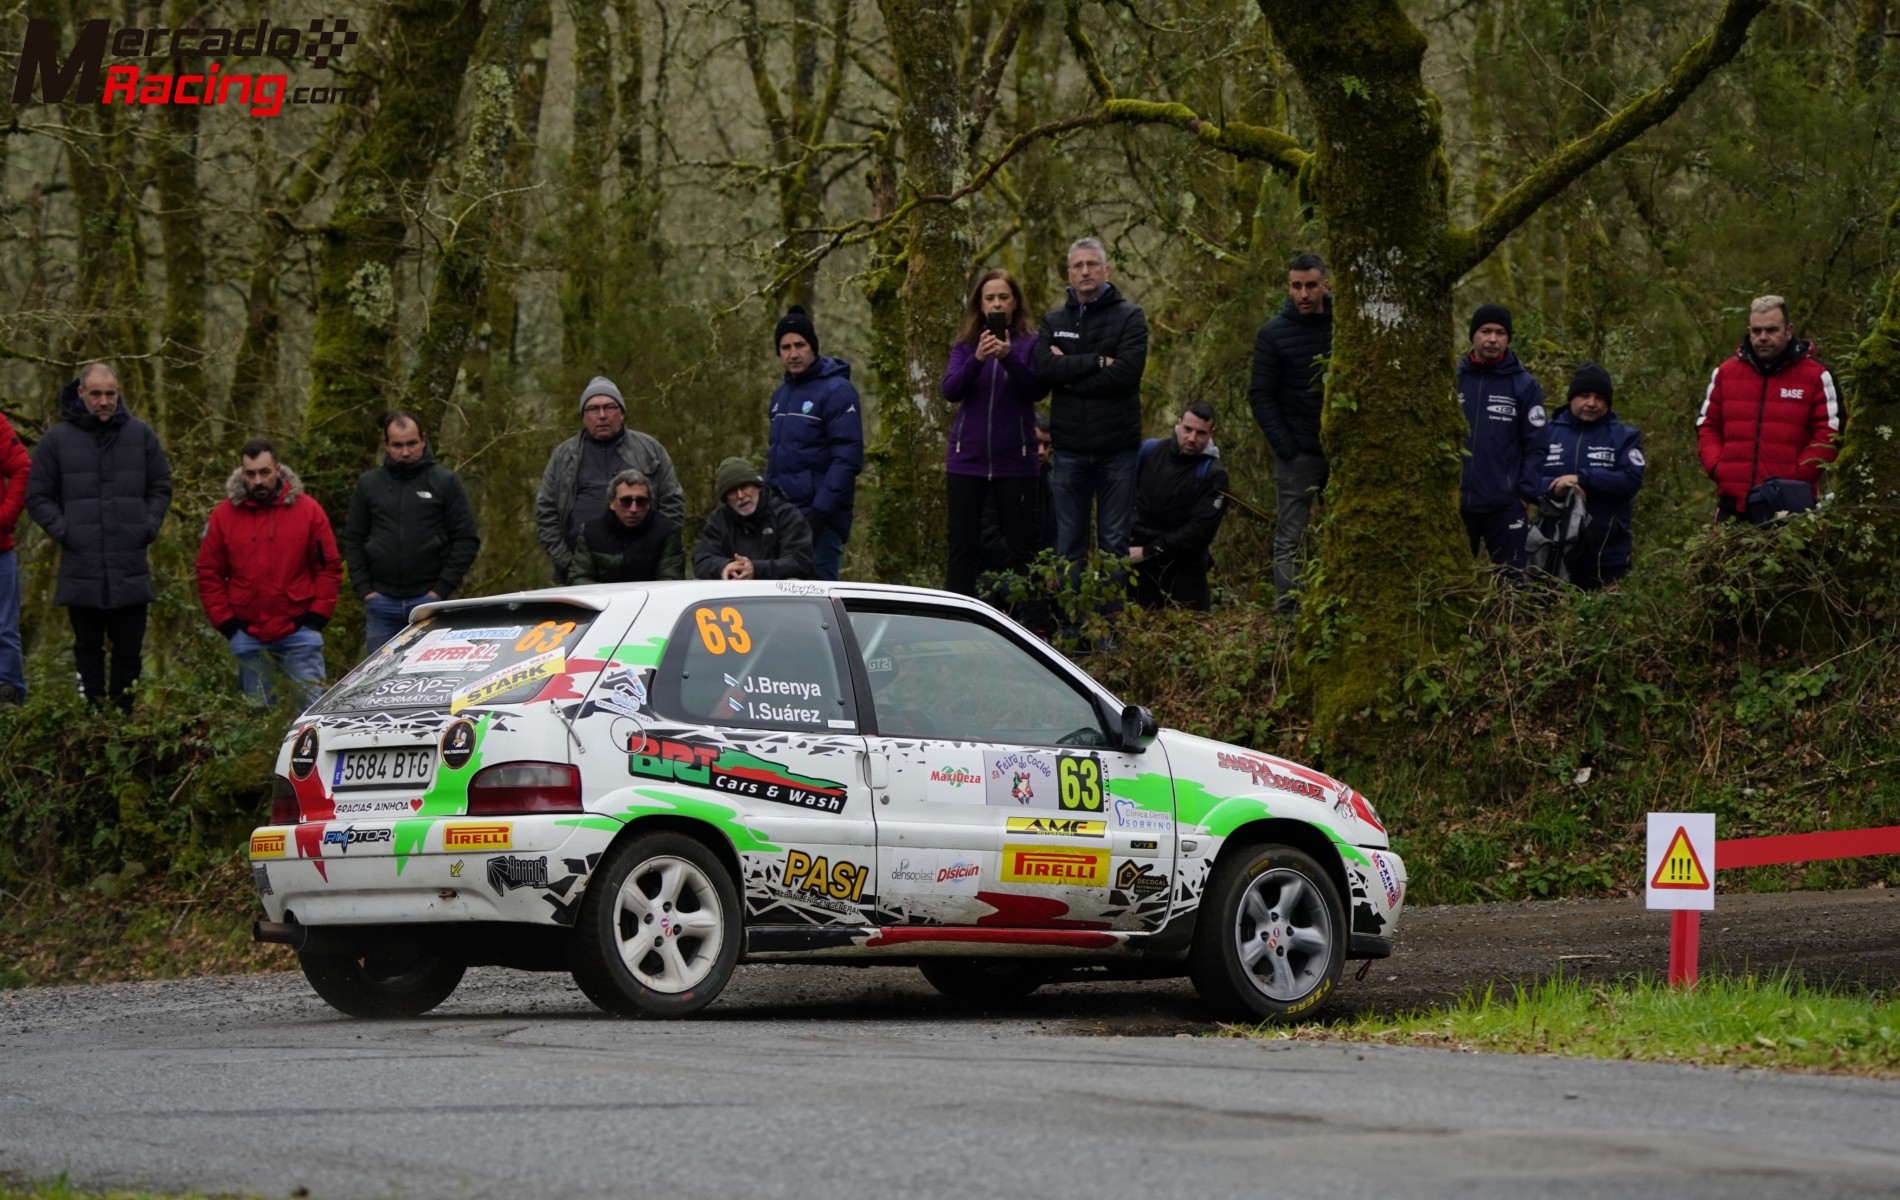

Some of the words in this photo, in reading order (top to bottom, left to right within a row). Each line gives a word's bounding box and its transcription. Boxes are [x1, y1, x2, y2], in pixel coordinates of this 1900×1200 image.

[1780, 388, 1804, 399] BASE
[514, 620, 577, 653] 63
[696, 607, 751, 655] 63
[467, 661, 549, 703] STARK
[744, 677, 821, 700] J.Brenya
[366, 693, 446, 706] INFORMÁTICA
[597, 700, 623, 713] SERVICIOS
[623, 709, 653, 723] GENERALES
[748, 702, 821, 723] I.Suárez
[344, 752, 386, 781] 5684
[392, 751, 430, 780] BTG
[996, 754, 1019, 775] Feira
[1019, 755, 1027, 769] do
[1027, 755, 1051, 778] Cocido
[931, 770, 981, 784] MaxiDeza
[1060, 757, 1100, 810] 63
[715, 775, 757, 794] Cars
[766, 786, 779, 798] &
[789, 789, 841, 811] Wash
[335, 803, 372, 814] GRACIAS
[374, 801, 409, 812] AINHOA
[1149, 811, 1171, 820] Dental
[445, 826, 510, 845] PIRELLI
[1125, 820, 1172, 830] SOBRINO
[251, 835, 285, 852] PIRELLI
[783, 850, 868, 902] PASI
[891, 869, 934, 882] densoplast
[1014, 852, 1098, 879] PIRELLI
[1137, 878, 1166, 886] DECOGAL
[1376, 853, 1396, 902] TOXEIRO
[1379, 871, 1388, 890] NOIA
[829, 900, 861, 914] GENERAL
